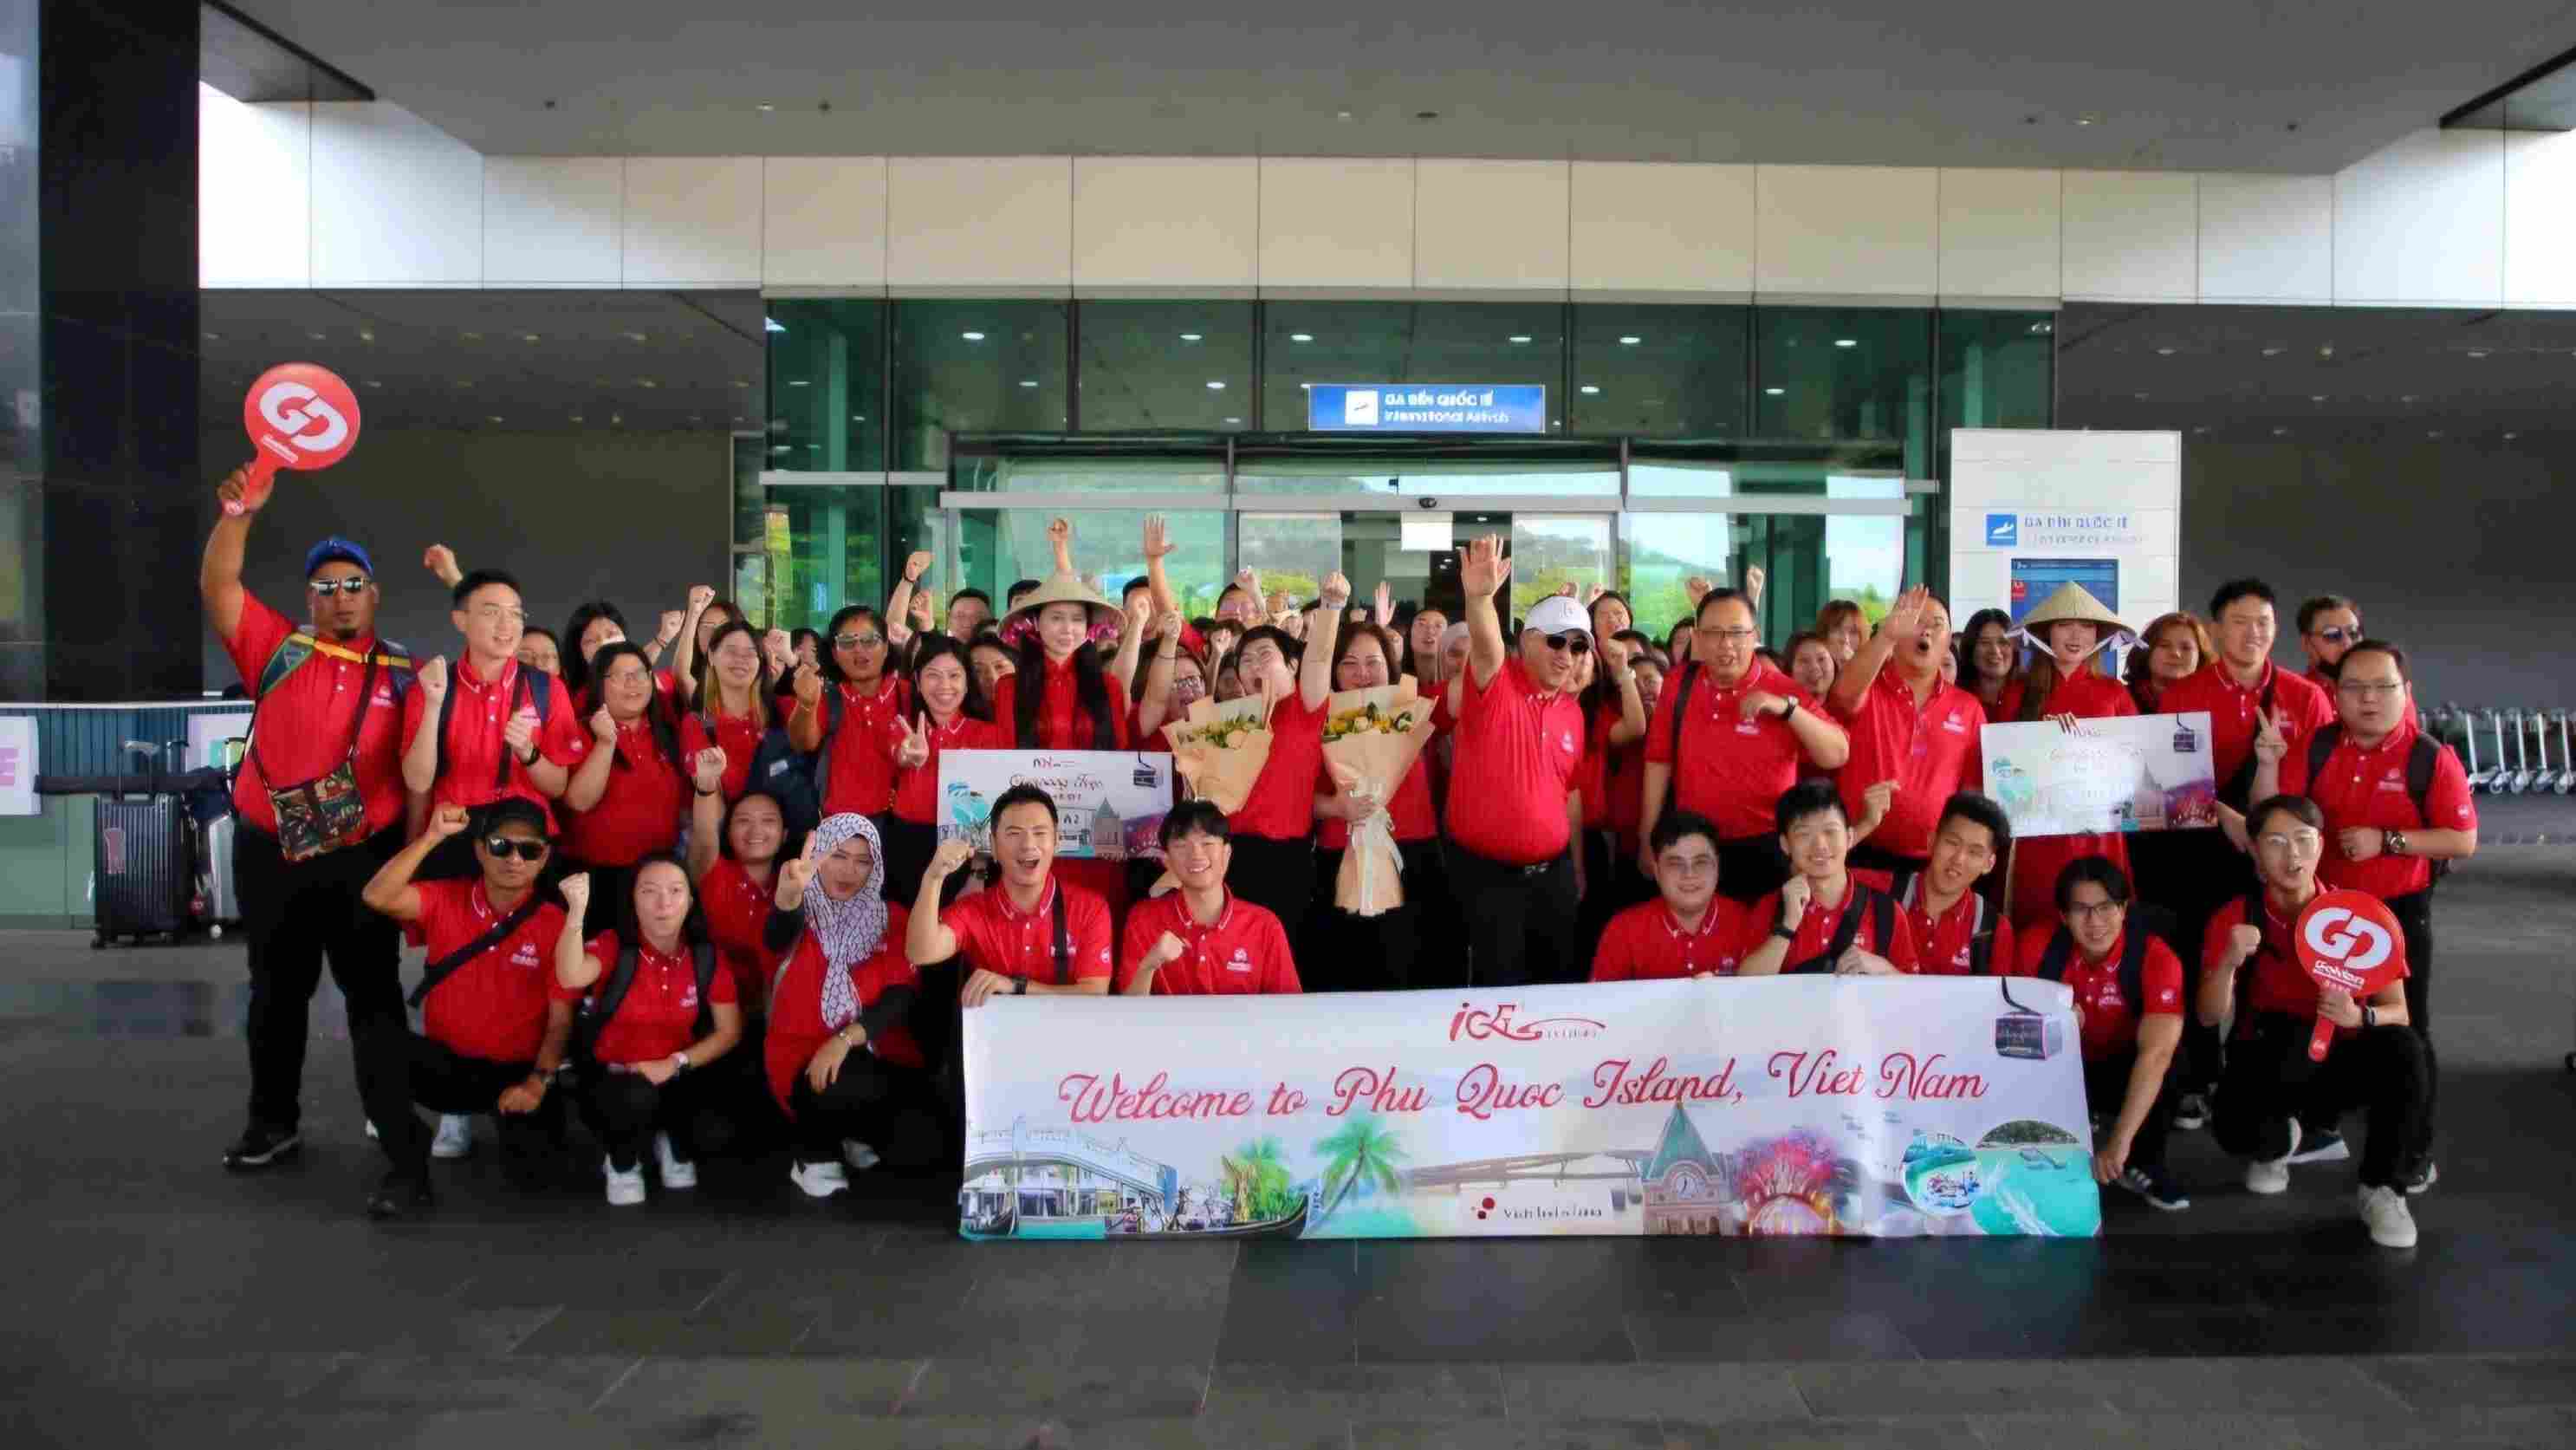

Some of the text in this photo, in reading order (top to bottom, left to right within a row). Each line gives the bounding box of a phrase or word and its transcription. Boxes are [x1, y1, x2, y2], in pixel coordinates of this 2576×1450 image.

[1058, 1049, 1990, 1123] Welcome to Phu Quoc Island, Viet Nam
